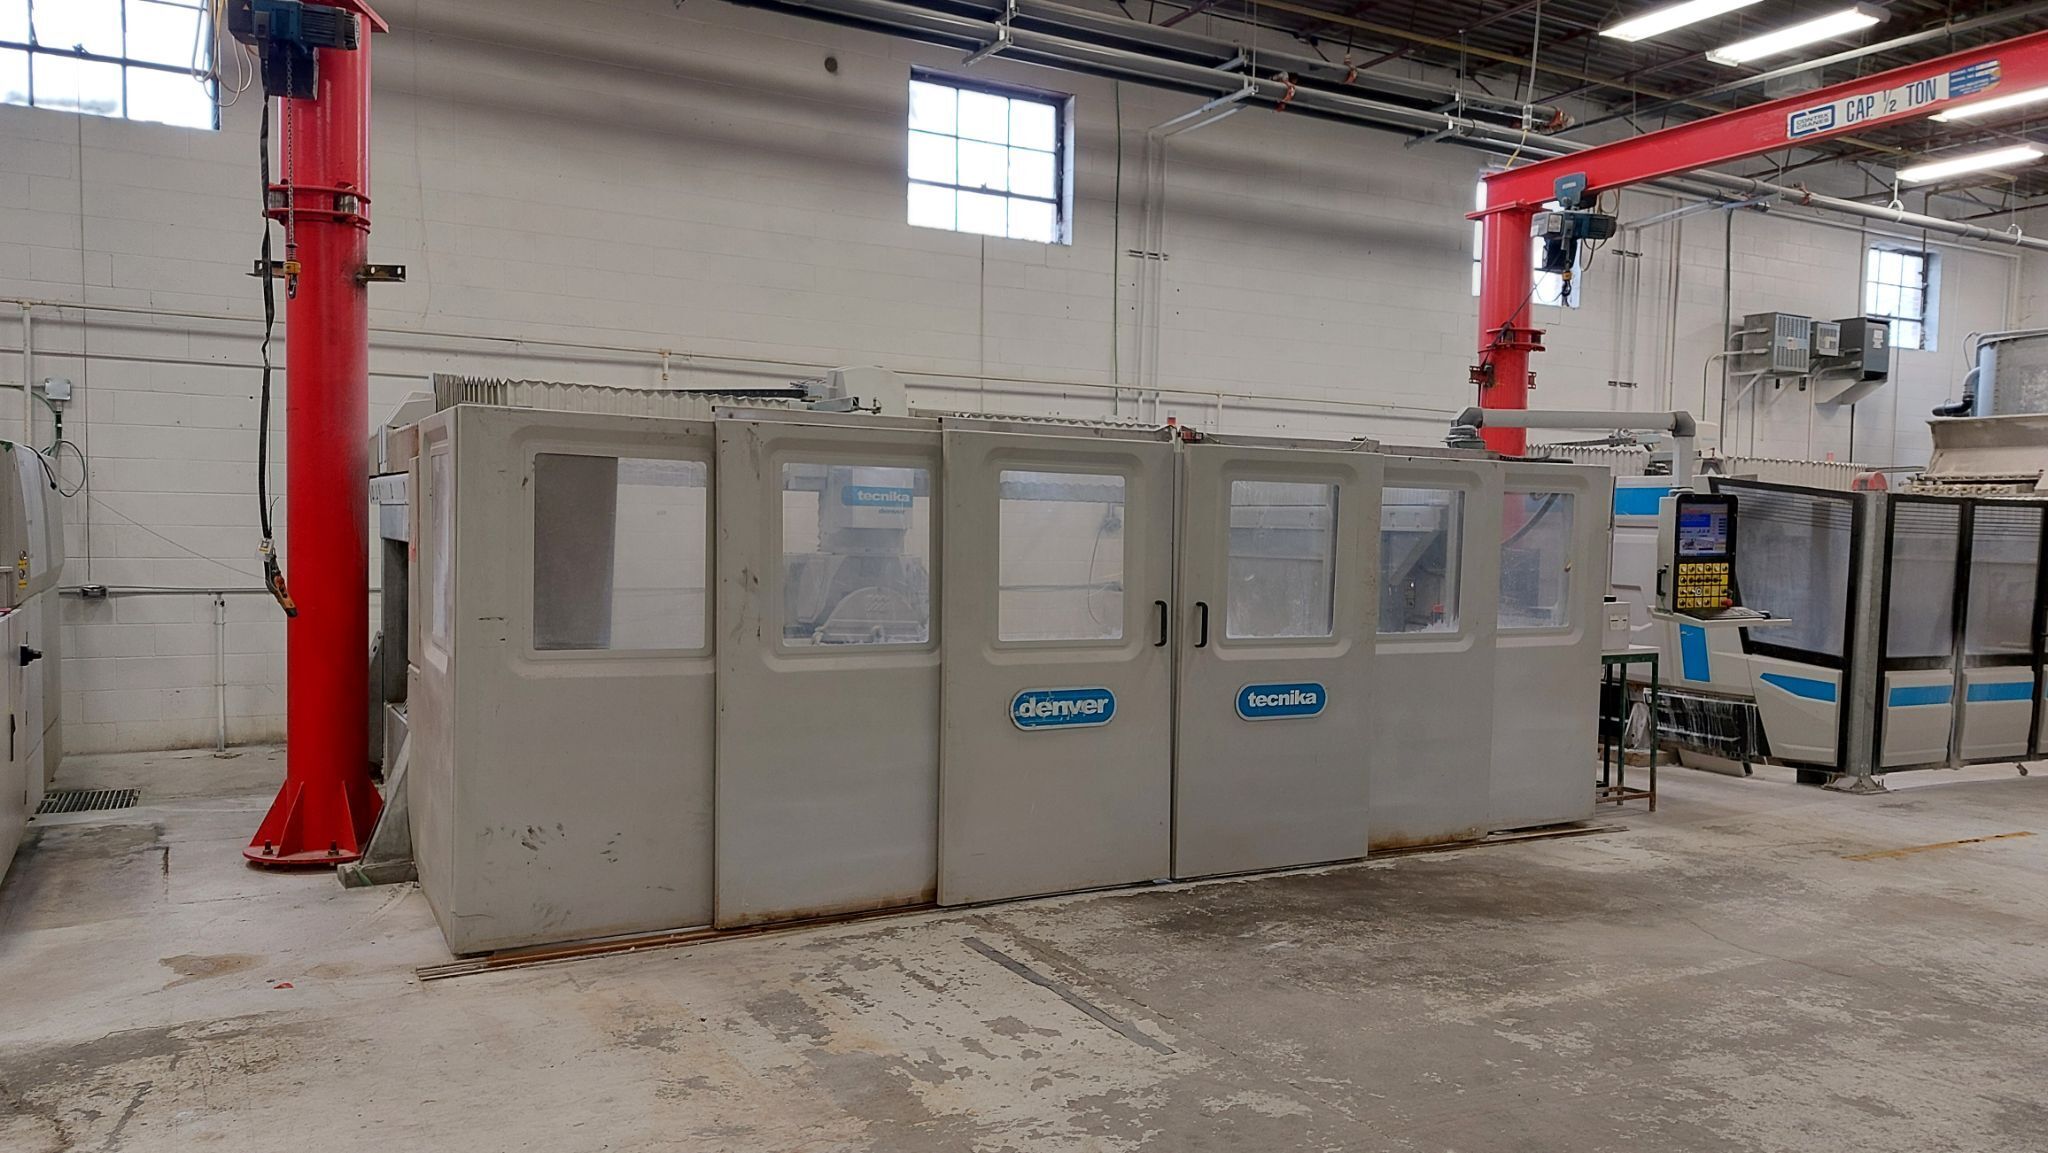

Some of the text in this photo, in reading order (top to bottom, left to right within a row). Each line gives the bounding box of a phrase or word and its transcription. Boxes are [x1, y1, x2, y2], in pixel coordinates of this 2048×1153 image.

[1906, 78, 1937, 106] TON
[857, 490, 910, 502] tecnika
[1019, 696, 1109, 718] denver
[1247, 689, 1317, 708] tecnika
